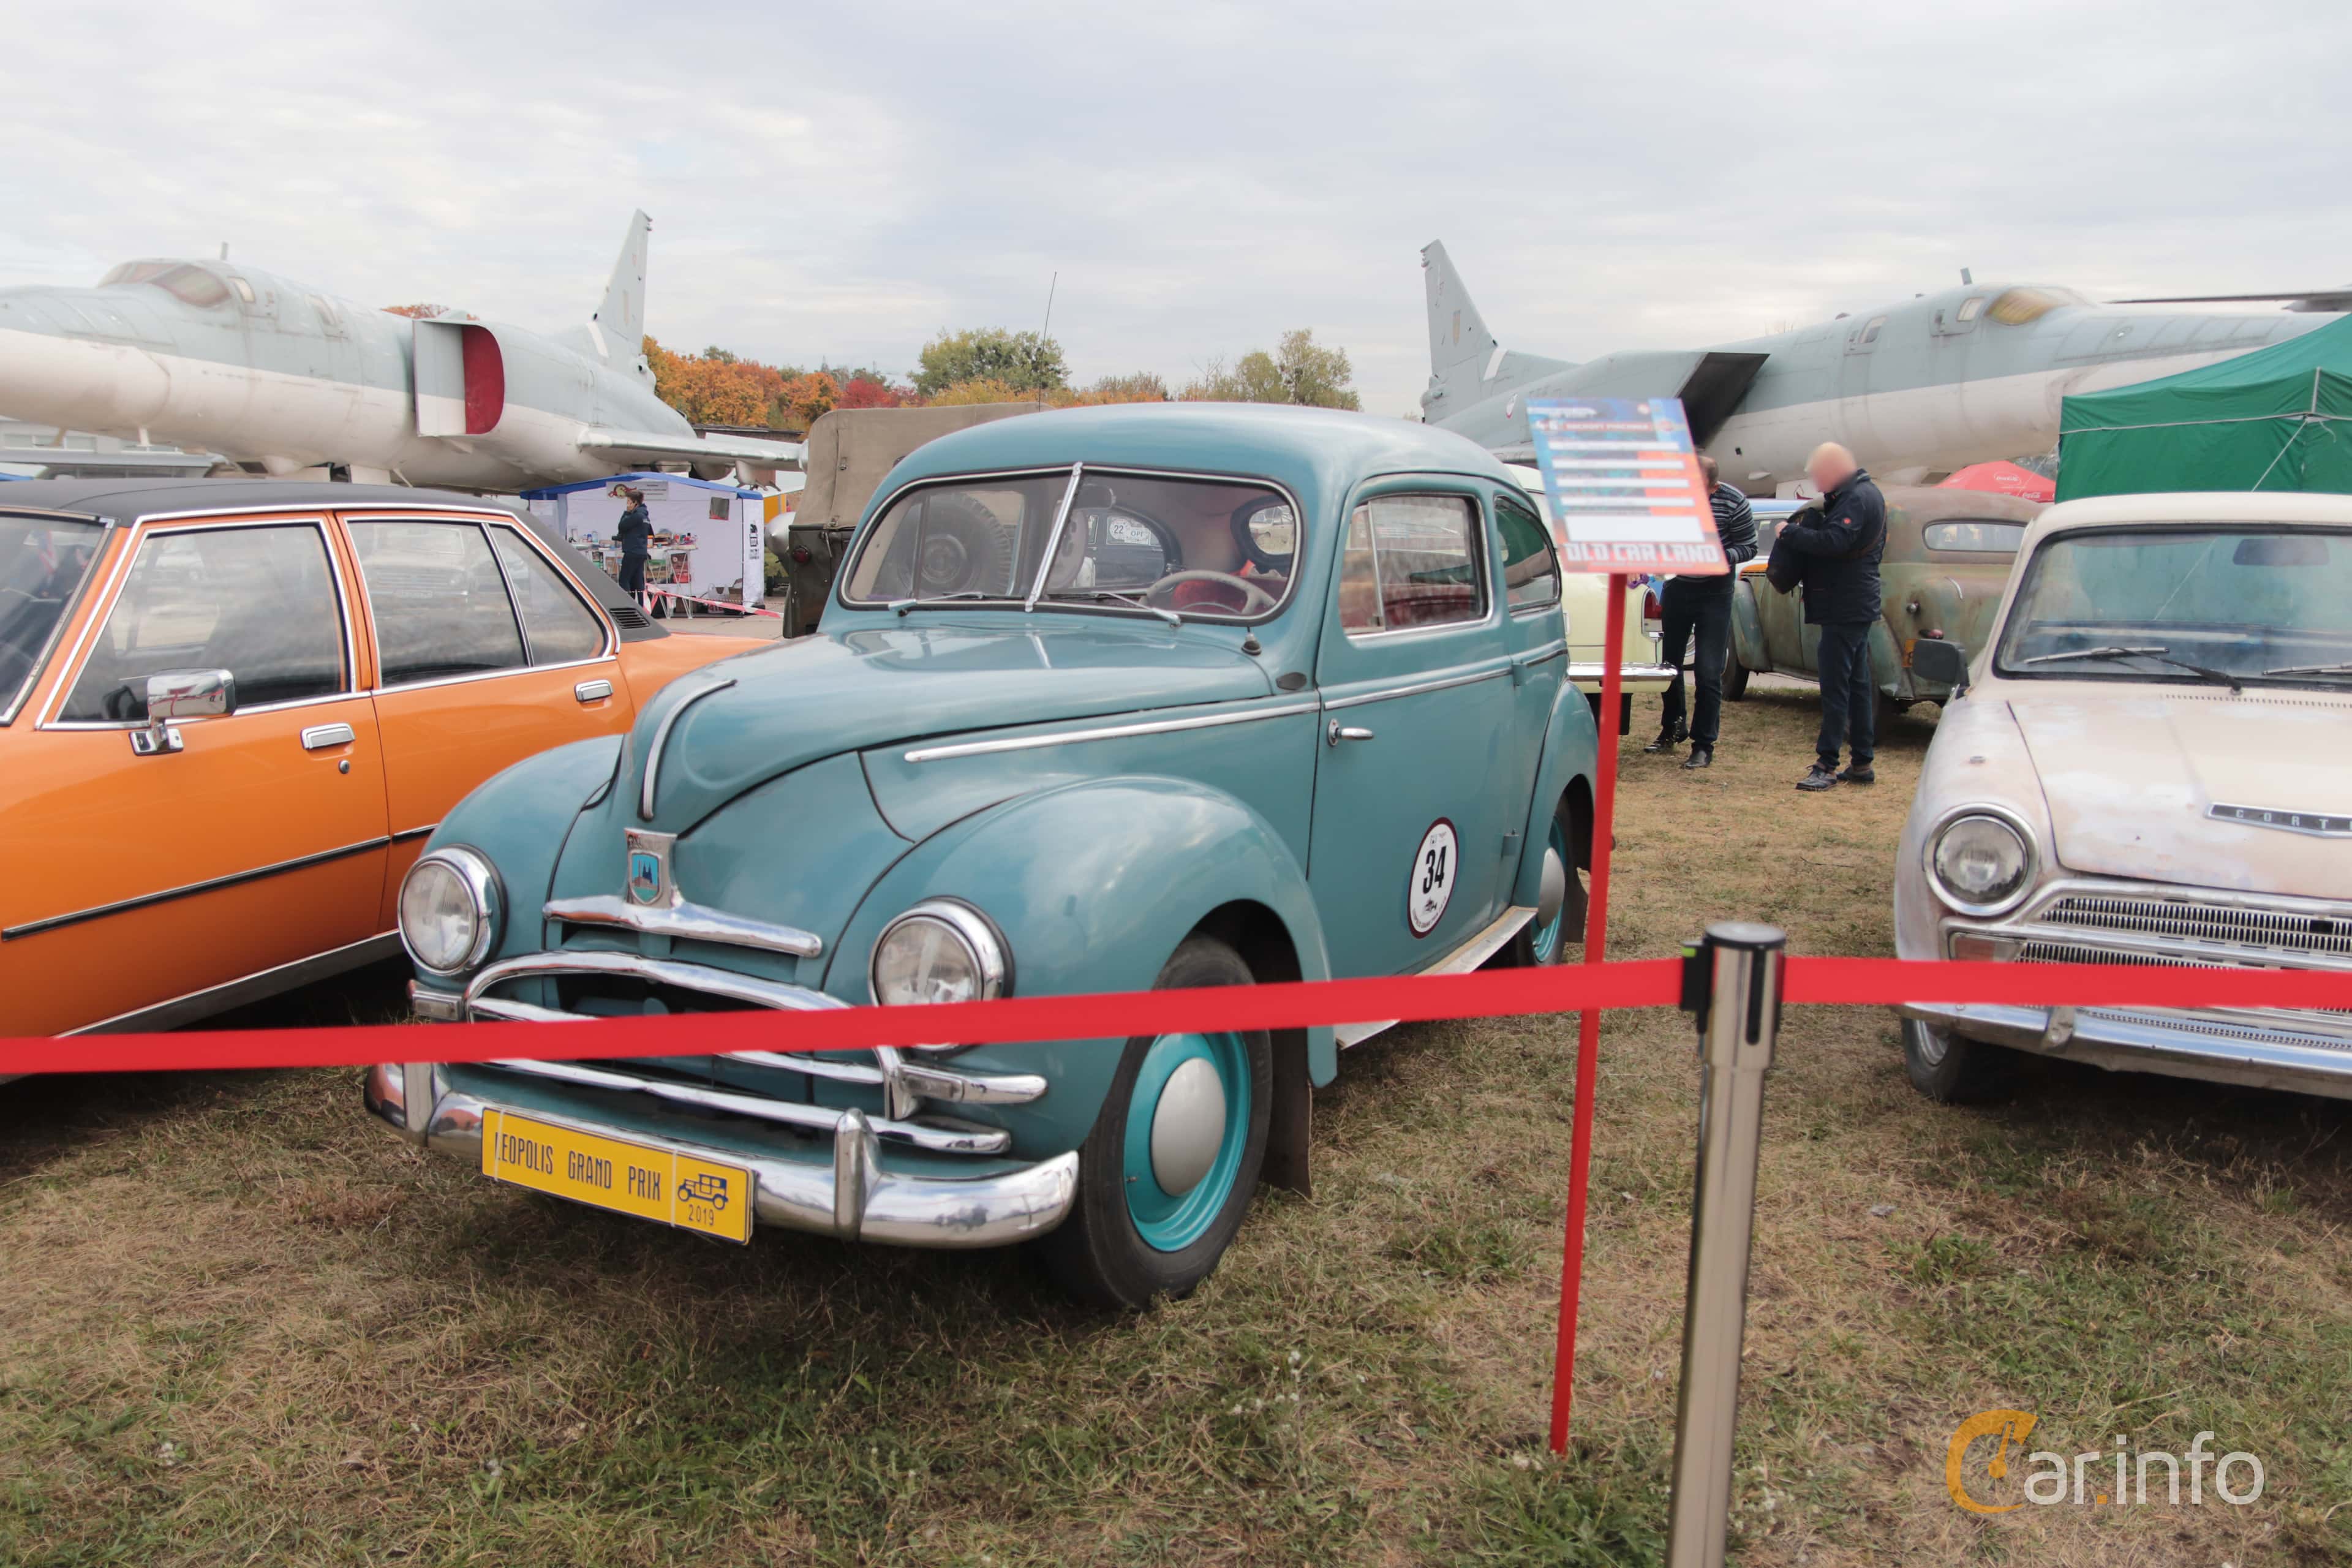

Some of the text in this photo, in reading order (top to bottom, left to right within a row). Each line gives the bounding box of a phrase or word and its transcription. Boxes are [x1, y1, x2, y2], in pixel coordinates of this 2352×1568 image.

[1114, 525, 1123, 534] 22
[1565, 544, 1720, 563] OLD CAR LAND
[1423, 846, 1447, 894] 34
[568, 1150, 612, 1189] GRAND
[628, 1166, 661, 1201] PRIX
[688, 1204, 715, 1226] 2019
